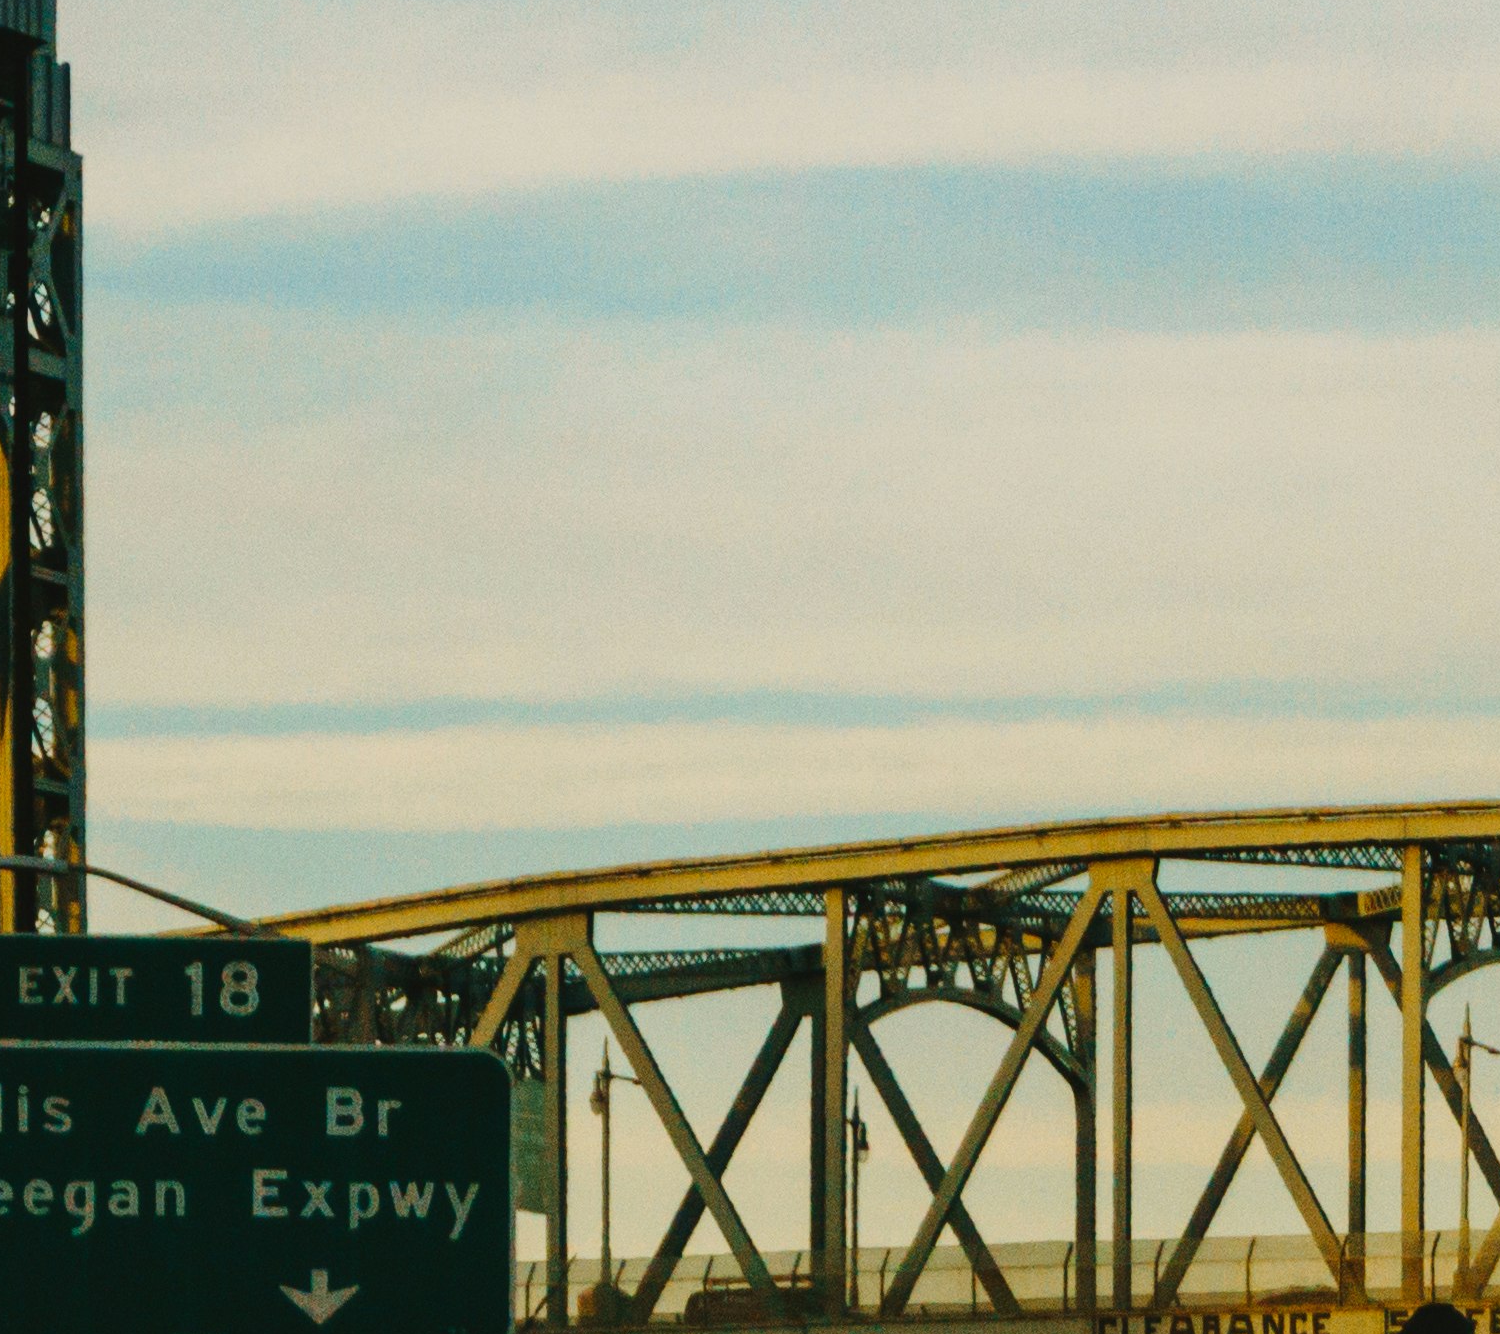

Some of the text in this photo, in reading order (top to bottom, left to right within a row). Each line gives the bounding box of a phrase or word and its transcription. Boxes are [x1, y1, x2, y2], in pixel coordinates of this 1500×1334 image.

[18, 961, 260, 1017] EXIT 18
[136, 1086, 267, 1135] Ave
[326, 1087, 402, 1137] Br
[252, 1168, 479, 1240] Expwy
